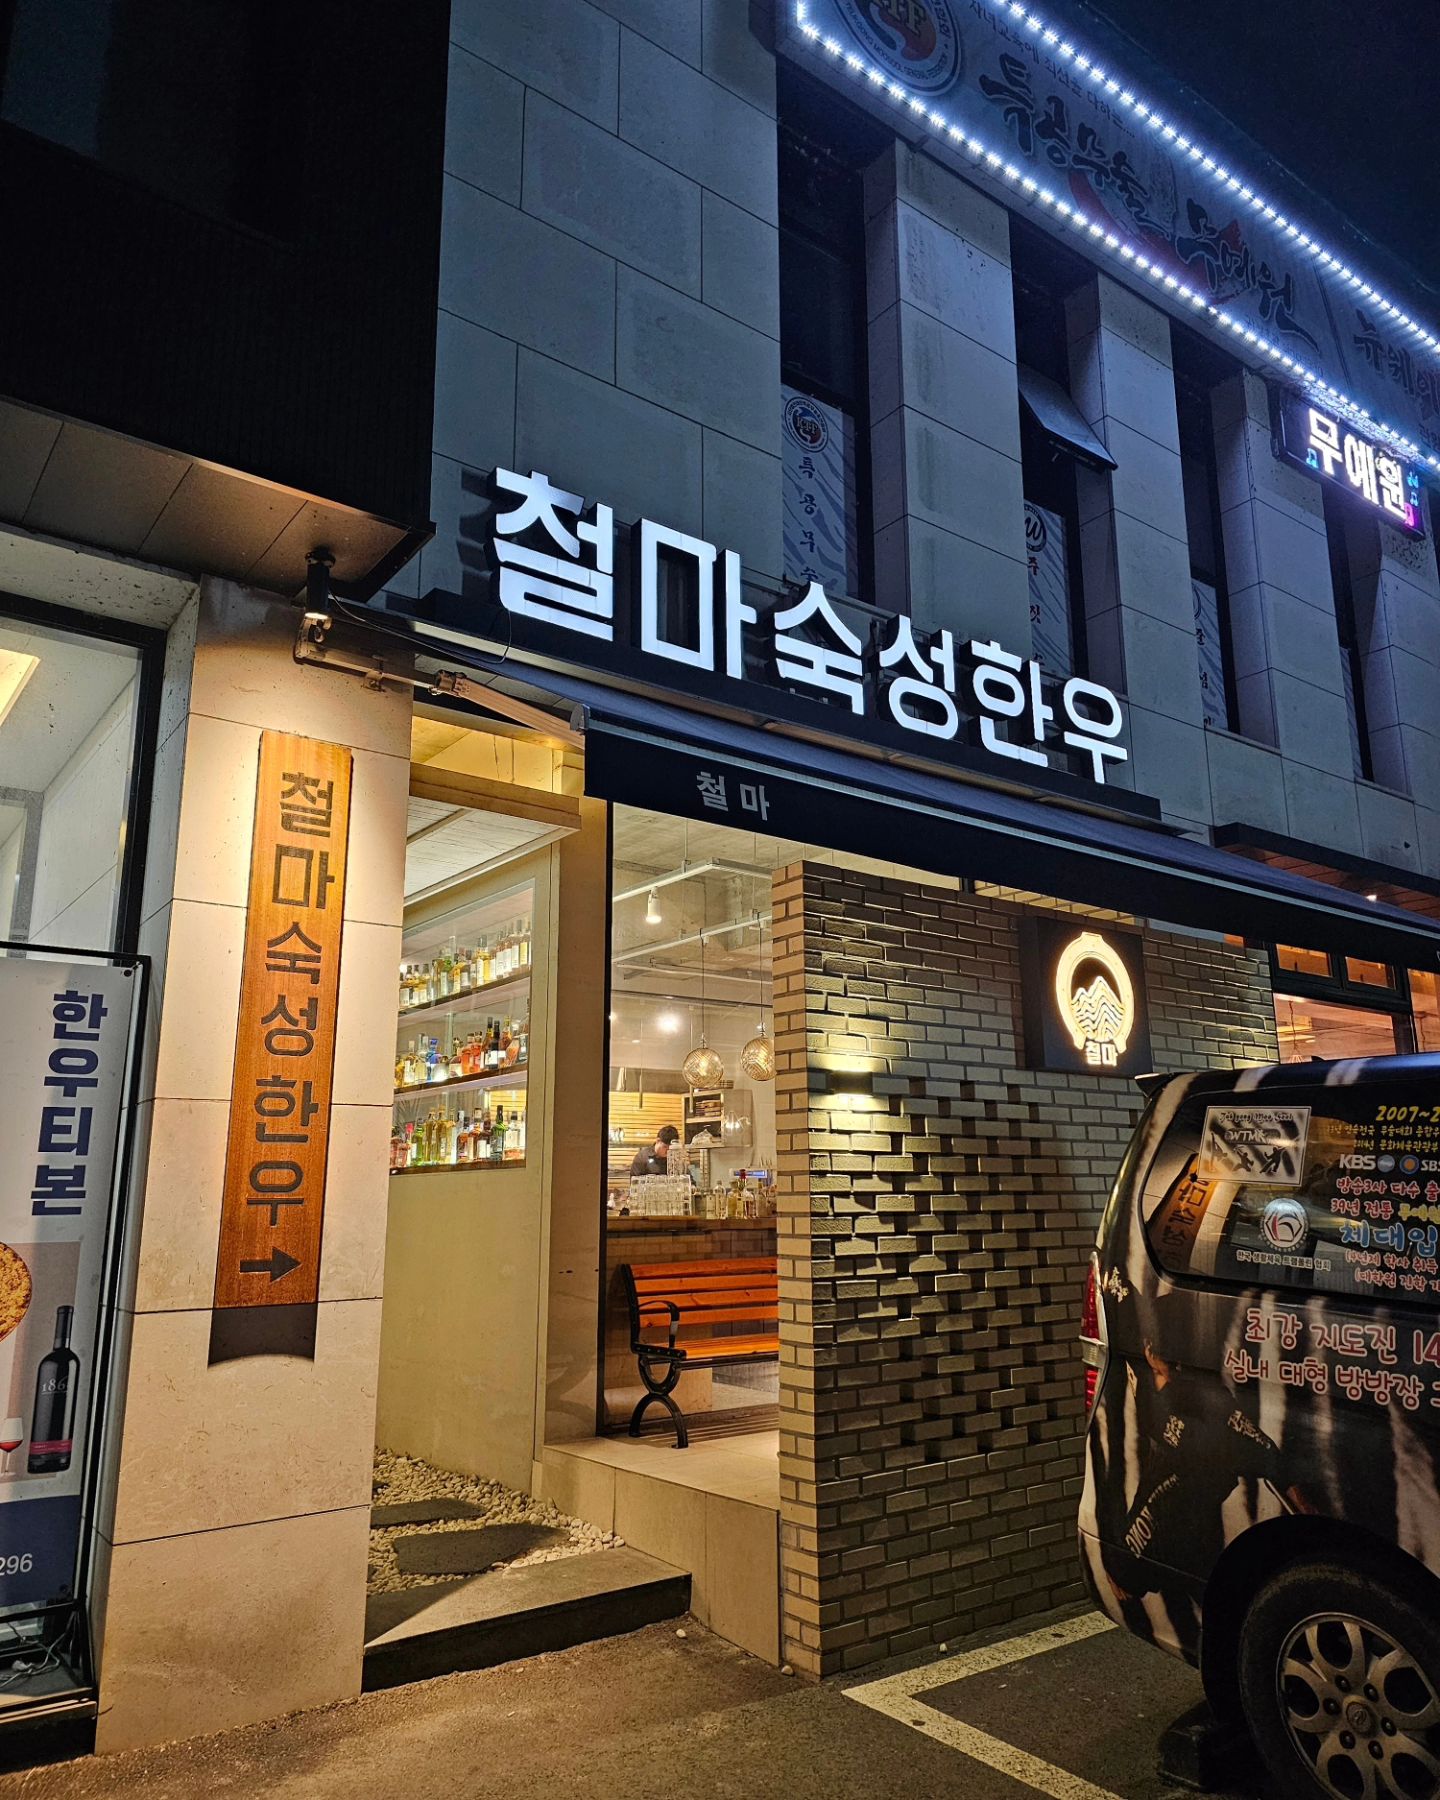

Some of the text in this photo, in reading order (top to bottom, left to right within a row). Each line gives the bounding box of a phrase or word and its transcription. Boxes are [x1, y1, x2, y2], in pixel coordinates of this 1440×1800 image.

[1308, 407, 1408, 521] 무예원
[494, 465, 1128, 784] 철마숙성한우
[247, 771, 335, 1227] 철마숙성한우
[1086, 1040, 1119, 1067] 철마
[31, 990, 108, 1216] 한우티본
[1336, 1176, 1388, 1196] 방송3사
[1390, 1181, 1421, 1199] 다수
[1339, 1153, 1377, 1170] KBS
[1331, 1198, 1361, 1217] 39년
[1364, 1200, 1395, 1220] 전통
[1245, 1308, 1303, 1350] 최강
[1309, 1323, 1398, 1365] 지도진
[1224, 1349, 1270, 1384] 실내
[1278, 1357, 1329, 1395] 대형
[1335, 1364, 1425, 1411] 방방장
